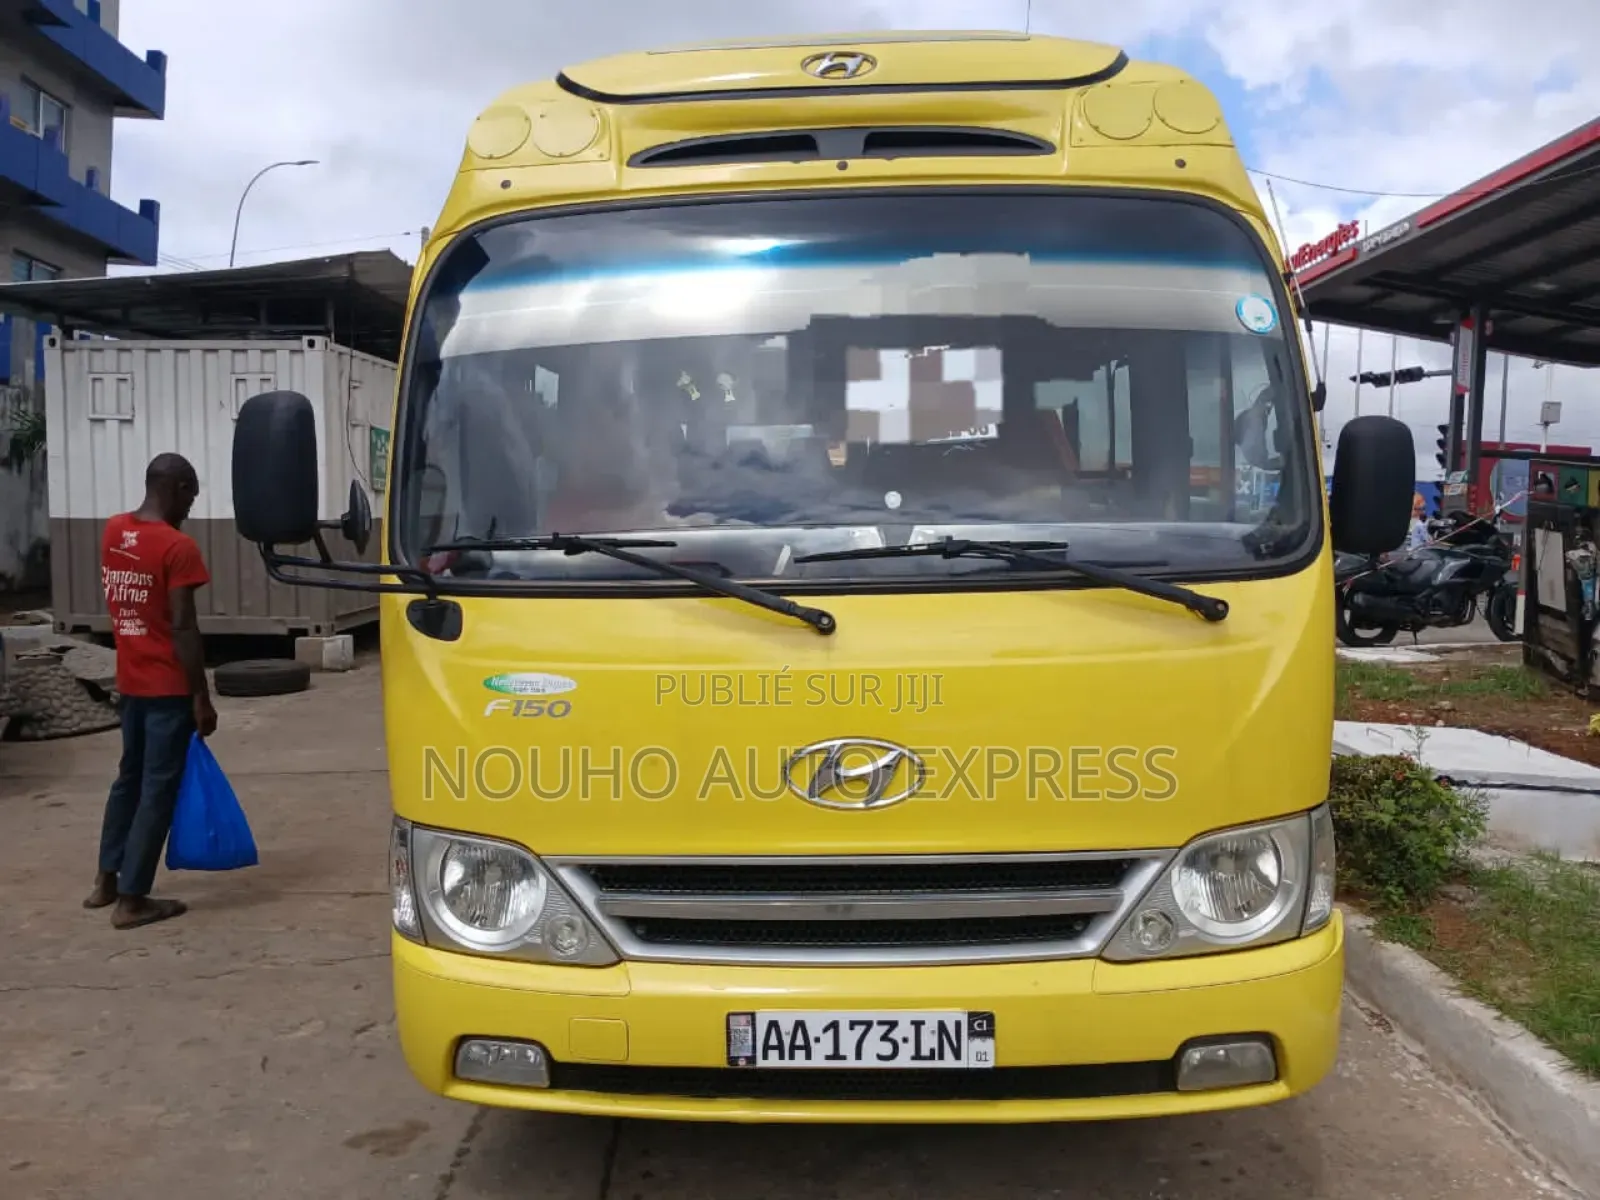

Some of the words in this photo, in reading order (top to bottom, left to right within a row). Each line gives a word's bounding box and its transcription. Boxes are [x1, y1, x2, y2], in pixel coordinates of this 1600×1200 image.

[483, 698, 573, 718] F150
[973, 1018, 988, 1031] CI
[975, 1050, 990, 1063] 01
